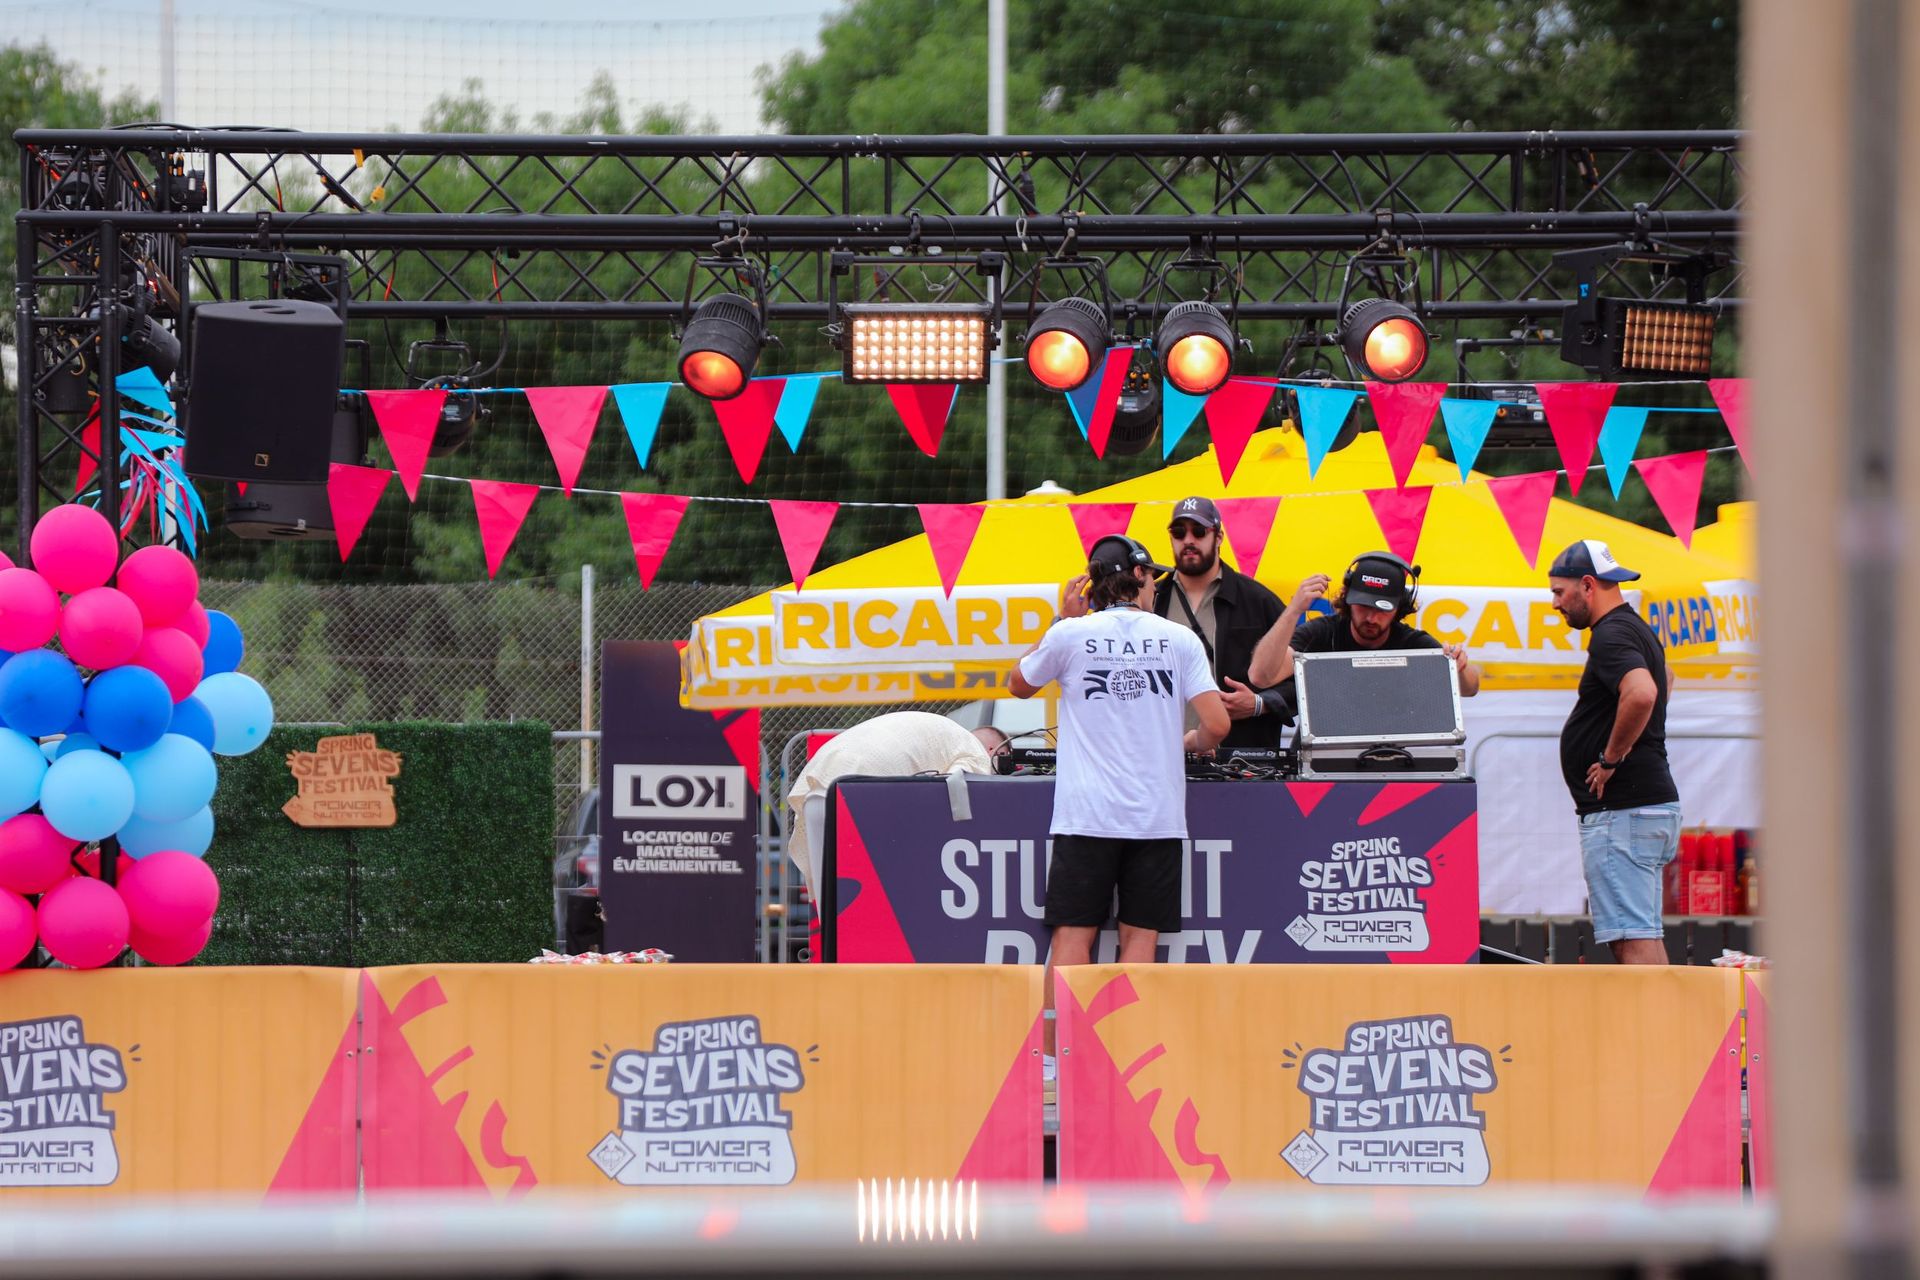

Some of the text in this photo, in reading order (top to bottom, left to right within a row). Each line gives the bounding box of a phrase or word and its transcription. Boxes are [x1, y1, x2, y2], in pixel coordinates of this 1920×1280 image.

[782, 596, 1055, 650] RICARD
[1648, 597, 1716, 648] RICARD
[1085, 639, 1169, 654] STAFF
[1111, 680, 1147, 692] SEVENS
[320, 736, 373, 755] SPRING
[295, 751, 396, 777] SEVENS
[302, 776, 390, 794] FESTIVAL
[631, 775, 726, 808] LOK
[313, 800, 381, 810] POWER
[622, 830, 734, 844] LOCATION DE
[1331, 837, 1400, 861] SPRING
[636, 843, 720, 858] MATÉRIEL
[941, 838, 1232, 919] STUT
[1299, 856, 1432, 890] SEVENS
[1307, 887, 1424, 912] FESTIVAL
[1324, 920, 1412, 932] POWER
[1324, 935, 1412, 943] NUTRITION
[0, 1020, 79, 1054] PRING
[657, 1019, 757, 1054] SPRING
[1350, 1019, 1448, 1054] SPRING
[611, 1047, 800, 1096] SEVENS
[1303, 1047, 1492, 1095] SEVENS
[623, 1092, 788, 1128] FESTIVAL
[1315, 1092, 1481, 1127] FESTIVAL
[0, 1141, 94, 1158] OWER
[645, 1140, 770, 1157] POWER
[1337, 1140, 1464, 1157] POWER
[645, 1161, 770, 1173] NUTRITION
[1337, 1161, 1464, 1173] NUTRITION
